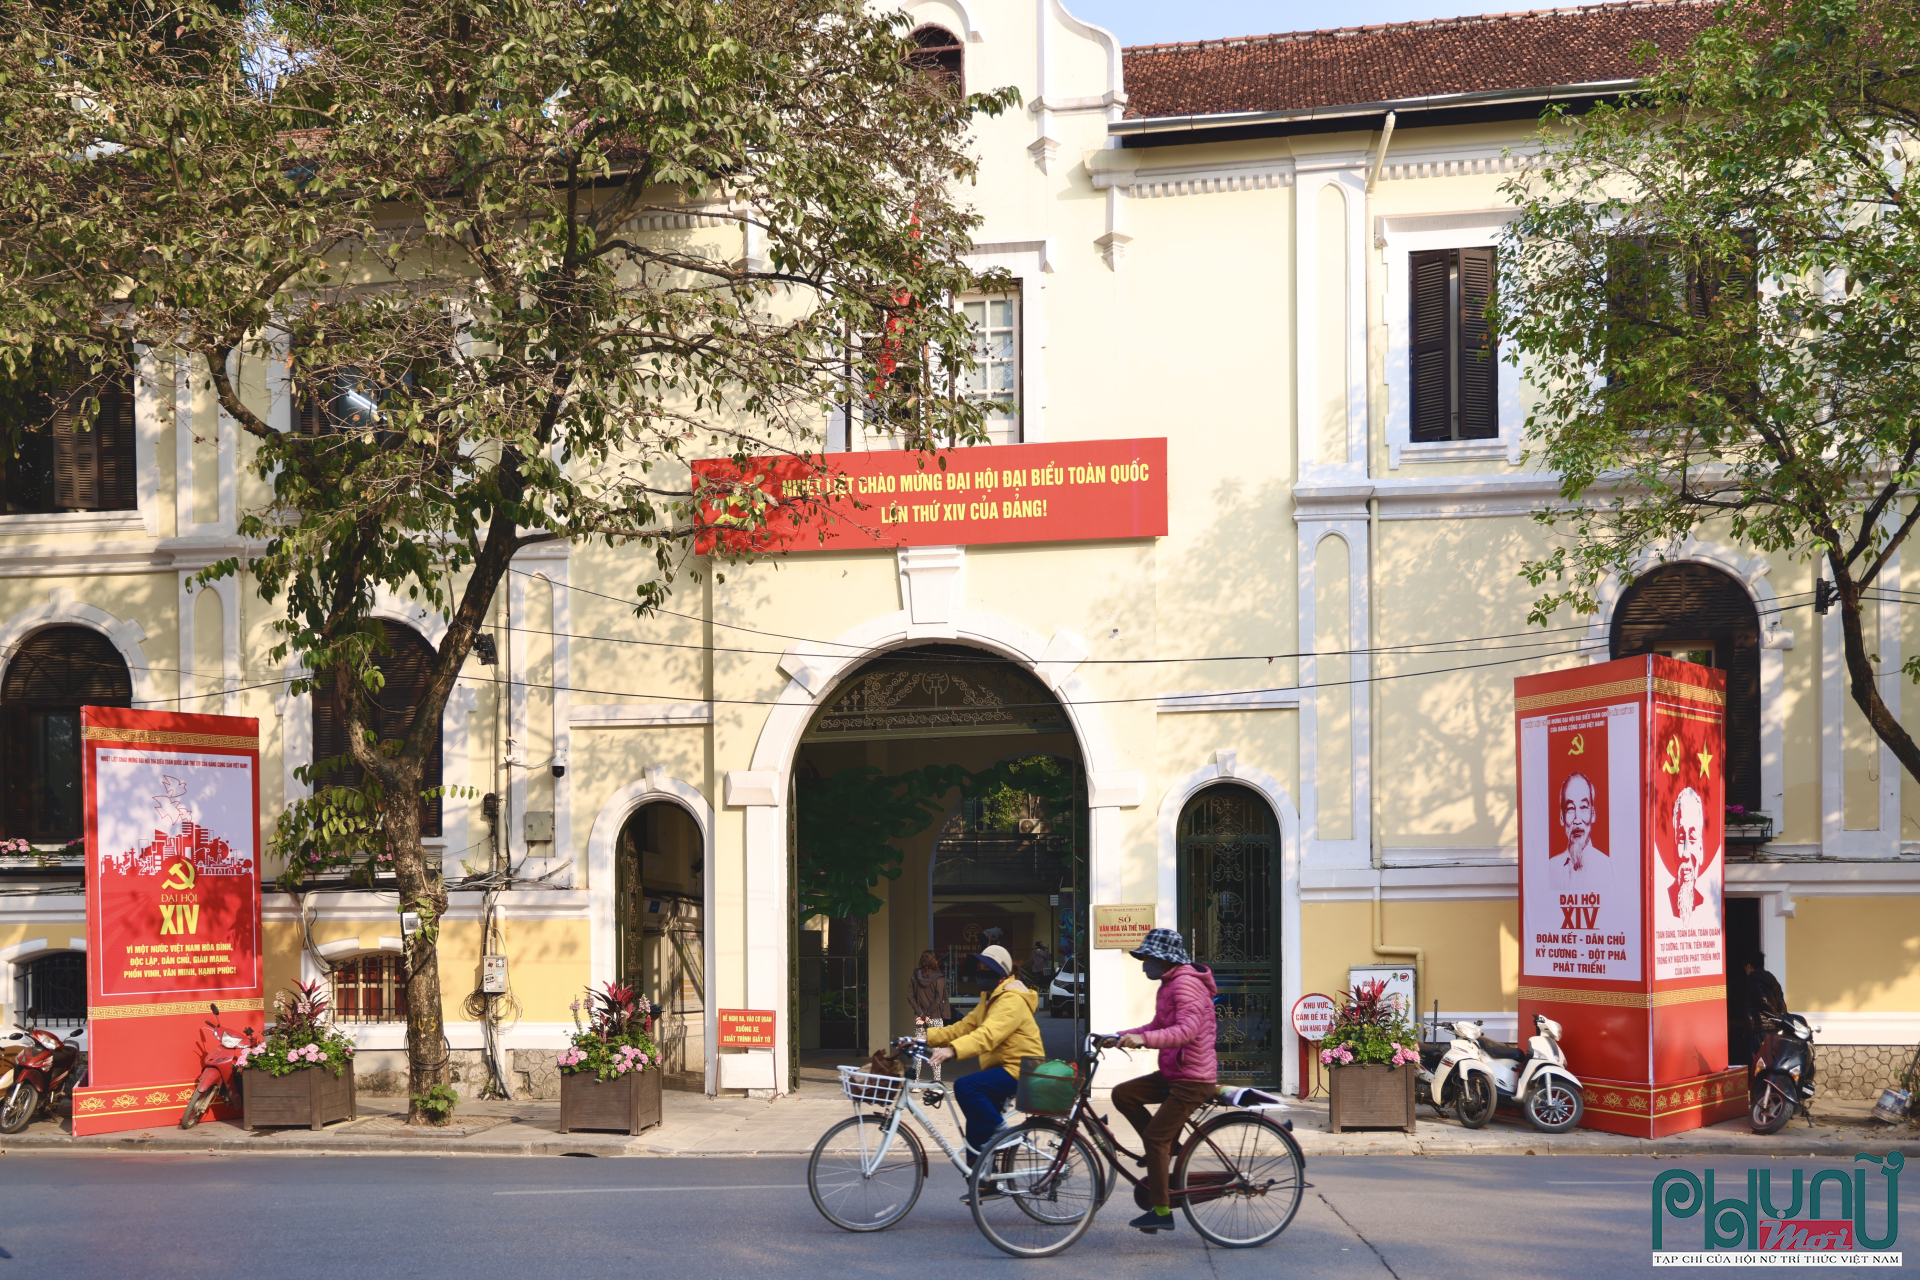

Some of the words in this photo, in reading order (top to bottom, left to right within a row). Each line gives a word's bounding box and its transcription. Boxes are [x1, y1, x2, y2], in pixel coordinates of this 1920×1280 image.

[858, 472, 895, 494] CHÀO
[900, 470, 943, 492] MỪNG
[946, 472, 970, 494] ĐẠI
[975, 467, 999, 493] HỘI
[1002, 469, 1027, 491] ĐẠI
[1032, 460, 1064, 486] BIỂU
[1068, 462, 1106, 484] TOÀN
[1110, 457, 1149, 484] QUỐC
[881, 500, 908, 523] LẦN
[912, 499, 941, 522] THỨ
[944, 503, 966, 521] XIV
[970, 495, 999, 520] CỦA
[1002, 493, 1047, 519] ĐẢNG!
[161, 893, 178, 904] ĐẠI
[181, 892, 198, 904] HỘI
[1560, 894, 1578, 907] ĐẠI
[1581, 891, 1600, 907] HỘI
[159, 904, 200, 935] XIV
[1118, 914, 1131, 923] SỞ
[1560, 906, 1600, 930] XIV
[1099, 924, 1109, 932] VĂN
[1121, 923, 1127, 931] VÀ
[1536, 932, 1559, 943] ĐOÀN
[1561, 931, 1577, 944] KẾT
[1586, 933, 1604, 945] DÂN
[1607, 931, 1625, 945] CHỦ
[126, 944, 133, 954] VÌ
[135, 944, 149, 955] MỘT
[151, 943, 169, 953] NƯỚC
[170, 943, 184, 954] VIỆT
[186, 944, 200, 952] NAM
[202, 942, 215, 952] HÒA
[216, 942, 233, 952] BÌNH,
[1536, 944, 1546, 958] KỶ
[1548, 948, 1577, 959] CƯƠNG
[1588, 948, 1605, 960] ĐỘT
[1608, 949, 1627, 961] PHÁ
[130, 956, 144, 967] ĐỘC
[146, 956, 160, 966] LẬP,
[162, 955, 175, 965] DÂN
[176, 953, 191, 965] CHỦ,
[193, 954, 208, 964] GIÀU
[210, 955, 230, 965] MẠNH,
[144, 969, 161, 978] VINH,
[163, 968, 176, 977] VĂN
[178, 968, 197, 977] MINH,
[198, 967, 216, 977] HẠNH
[217, 965, 236, 975] PHÚC!
[1553, 961, 1574, 972] PHÁT
[1577, 960, 1606, 974] TRIỂN!
[1317, 1001, 1328, 1010] VỰC
[1296, 1011, 1309, 1020] CẤM
[735, 1024, 752, 1032] XUỐNG
[724, 1034, 736, 1042] XUẤT
[752, 1034, 763, 1042] GIẤY
